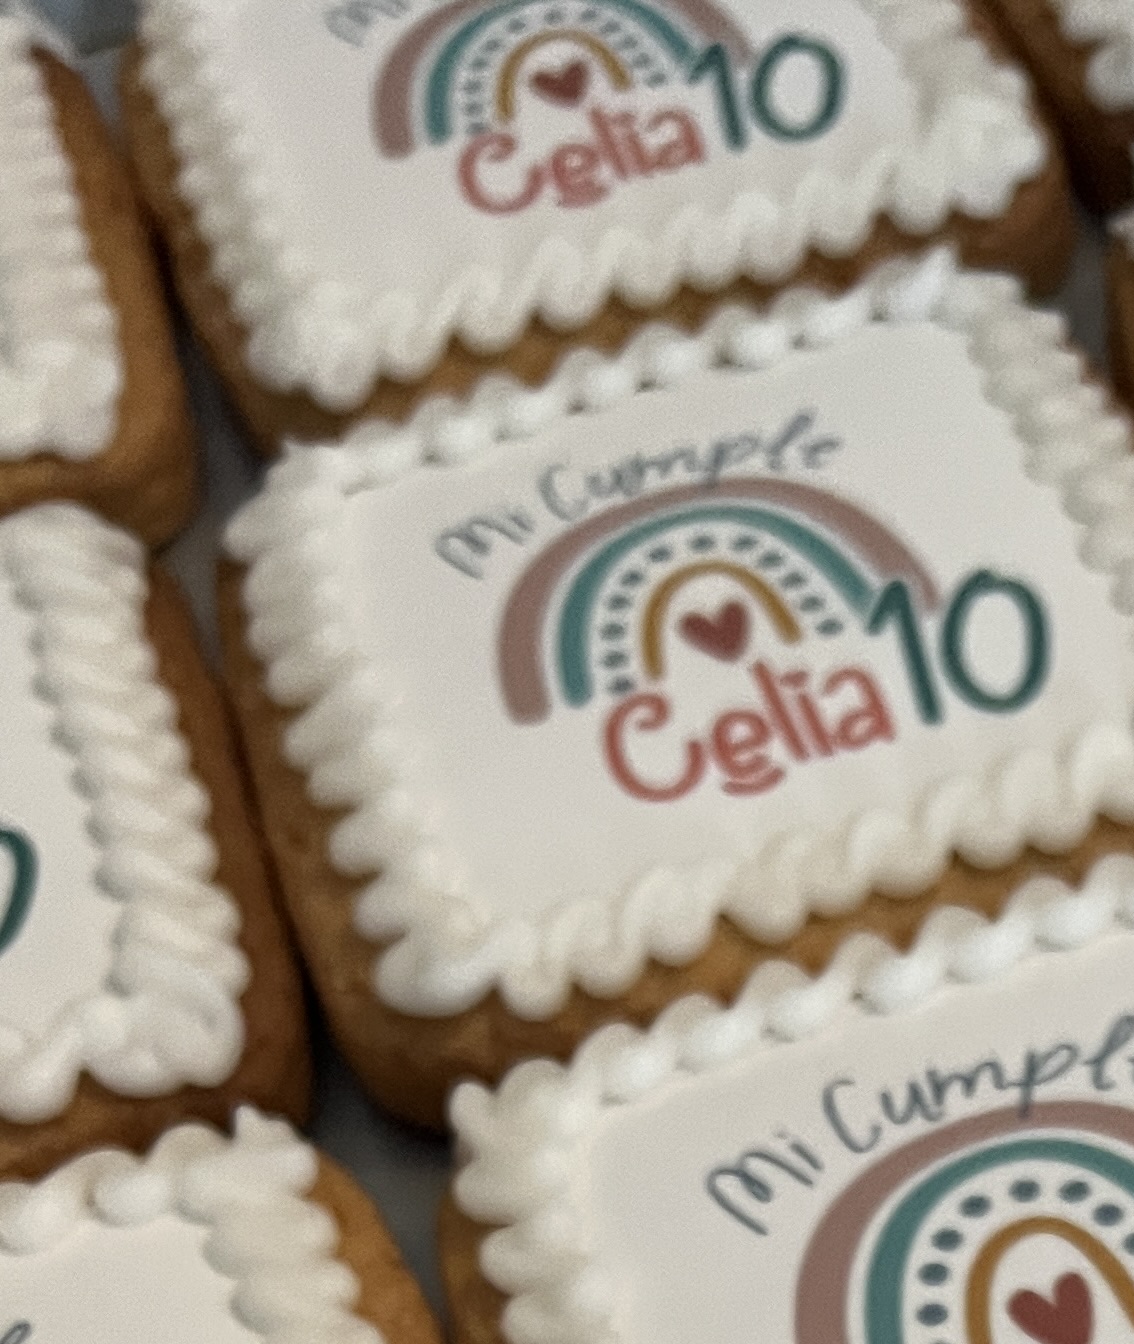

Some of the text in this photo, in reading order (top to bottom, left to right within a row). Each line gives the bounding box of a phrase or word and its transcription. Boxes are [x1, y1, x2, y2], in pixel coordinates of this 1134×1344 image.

[457, 32, 846, 216] Celia 10
[434, 408, 842, 580] Mi Cumple
[604, 567, 1052, 803] Celia 10
[705, 1131, 824, 1236] Mi
